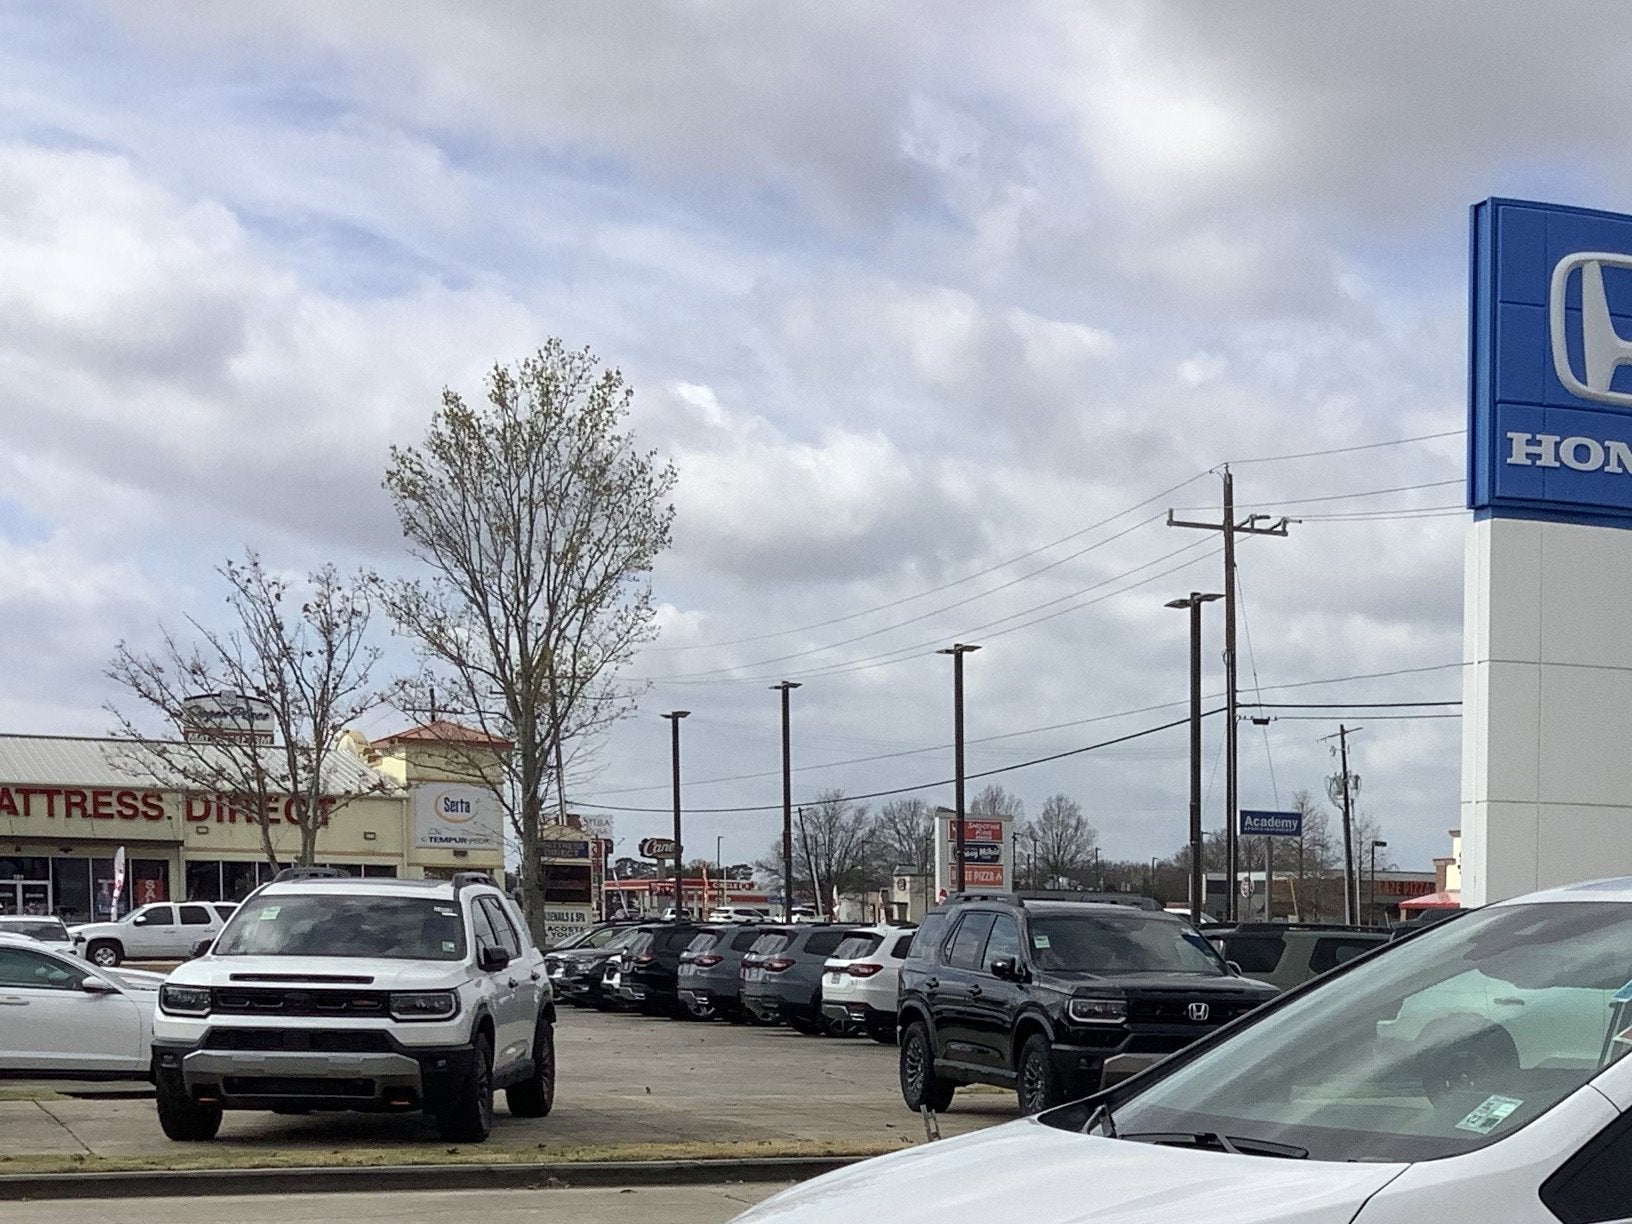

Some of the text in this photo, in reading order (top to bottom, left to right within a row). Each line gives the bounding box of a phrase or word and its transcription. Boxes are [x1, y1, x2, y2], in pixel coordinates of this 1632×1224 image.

[443, 796, 470, 814] Serta
[1244, 815, 1299, 831] Academy
[973, 871, 995, 881] PIZZA
